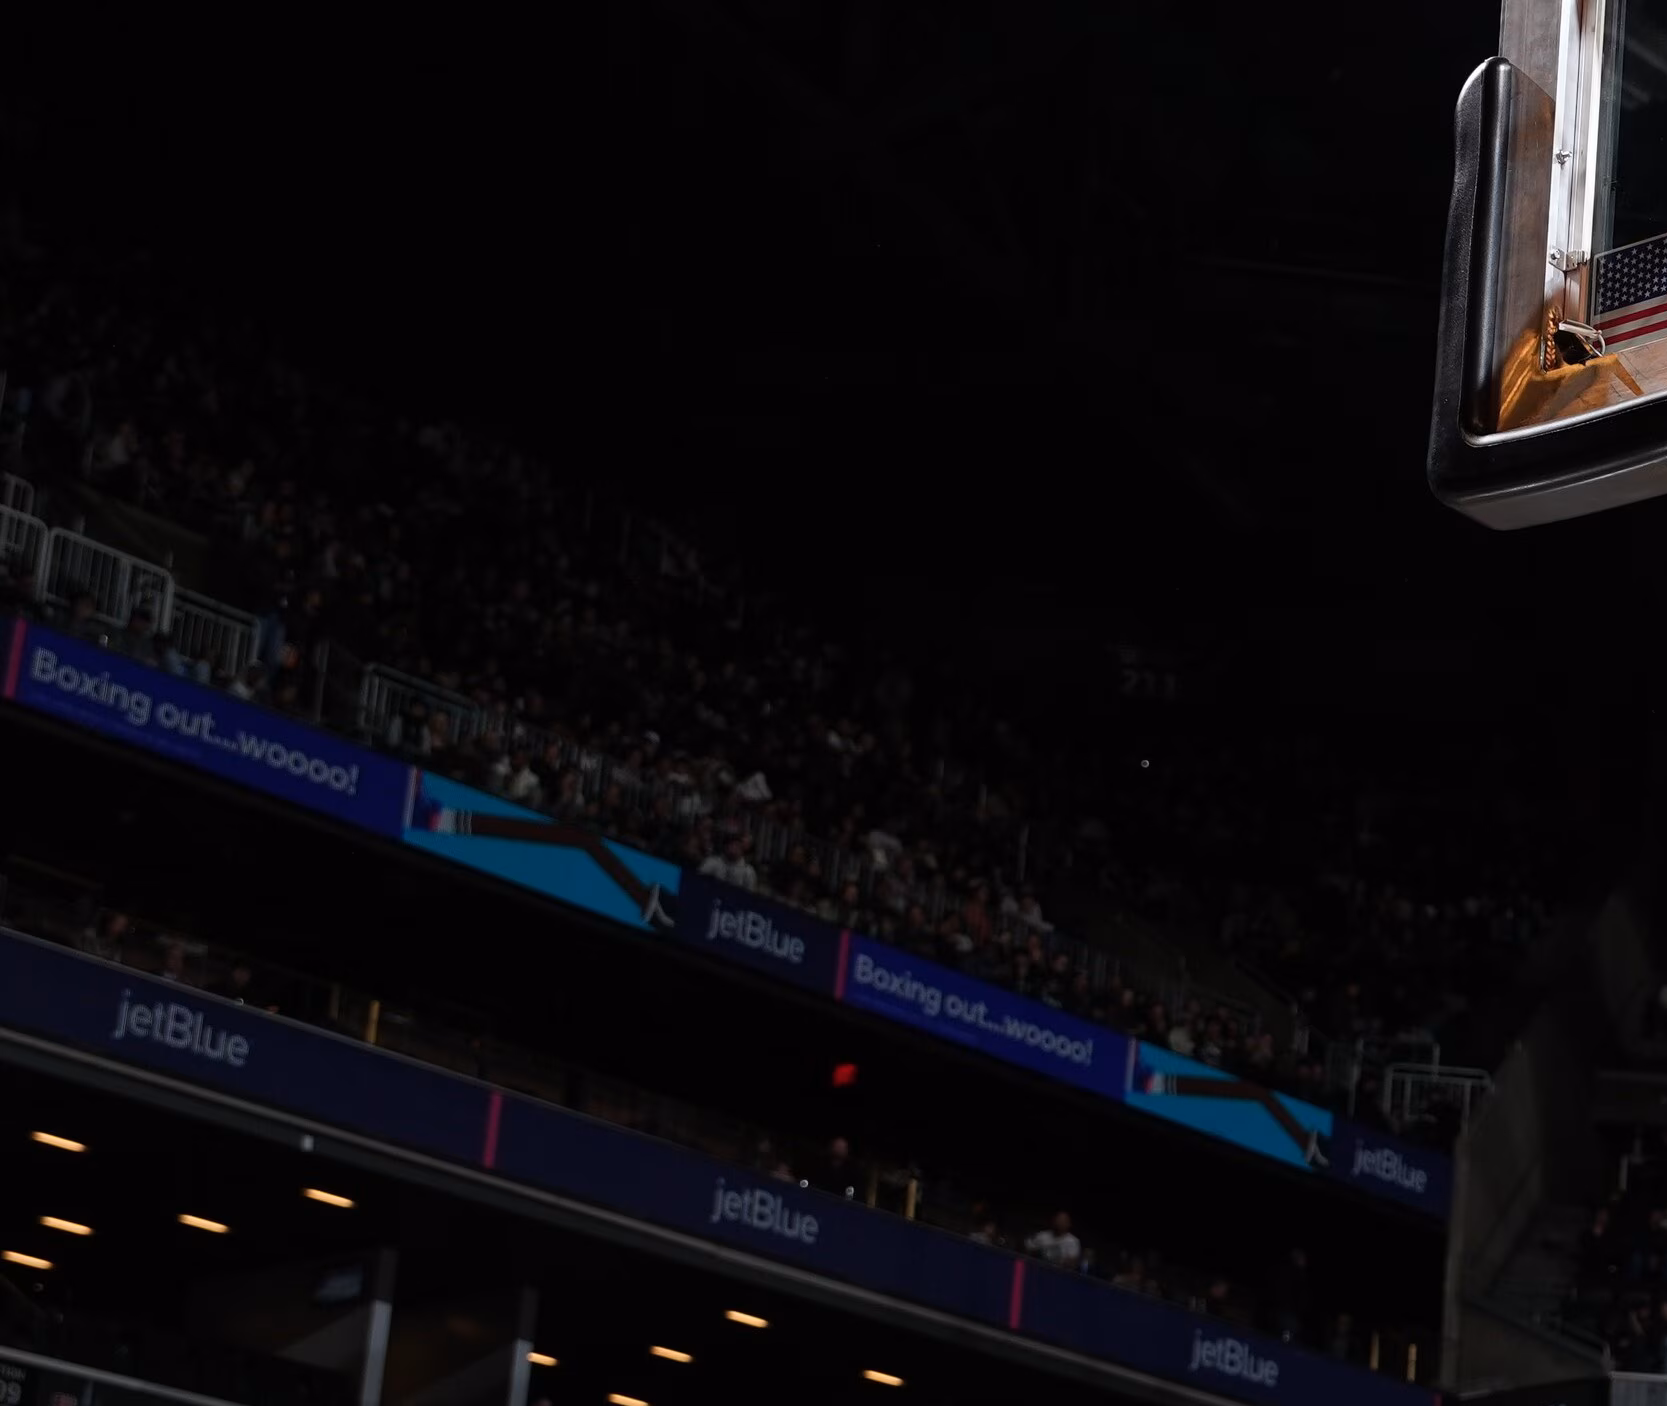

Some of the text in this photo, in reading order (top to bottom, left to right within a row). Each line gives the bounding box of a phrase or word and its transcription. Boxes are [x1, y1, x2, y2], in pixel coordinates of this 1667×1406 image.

[30, 647, 152, 727] Boxing
[706, 897, 806, 964] jetBlue
[853, 955, 942, 1019] Boxing
[111, 987, 250, 1067] jetBlue
[1351, 1138, 1429, 1194] jetBlue
[710, 1176, 820, 1245] jetBlue
[1186, 1328, 1280, 1388] jetBlue
